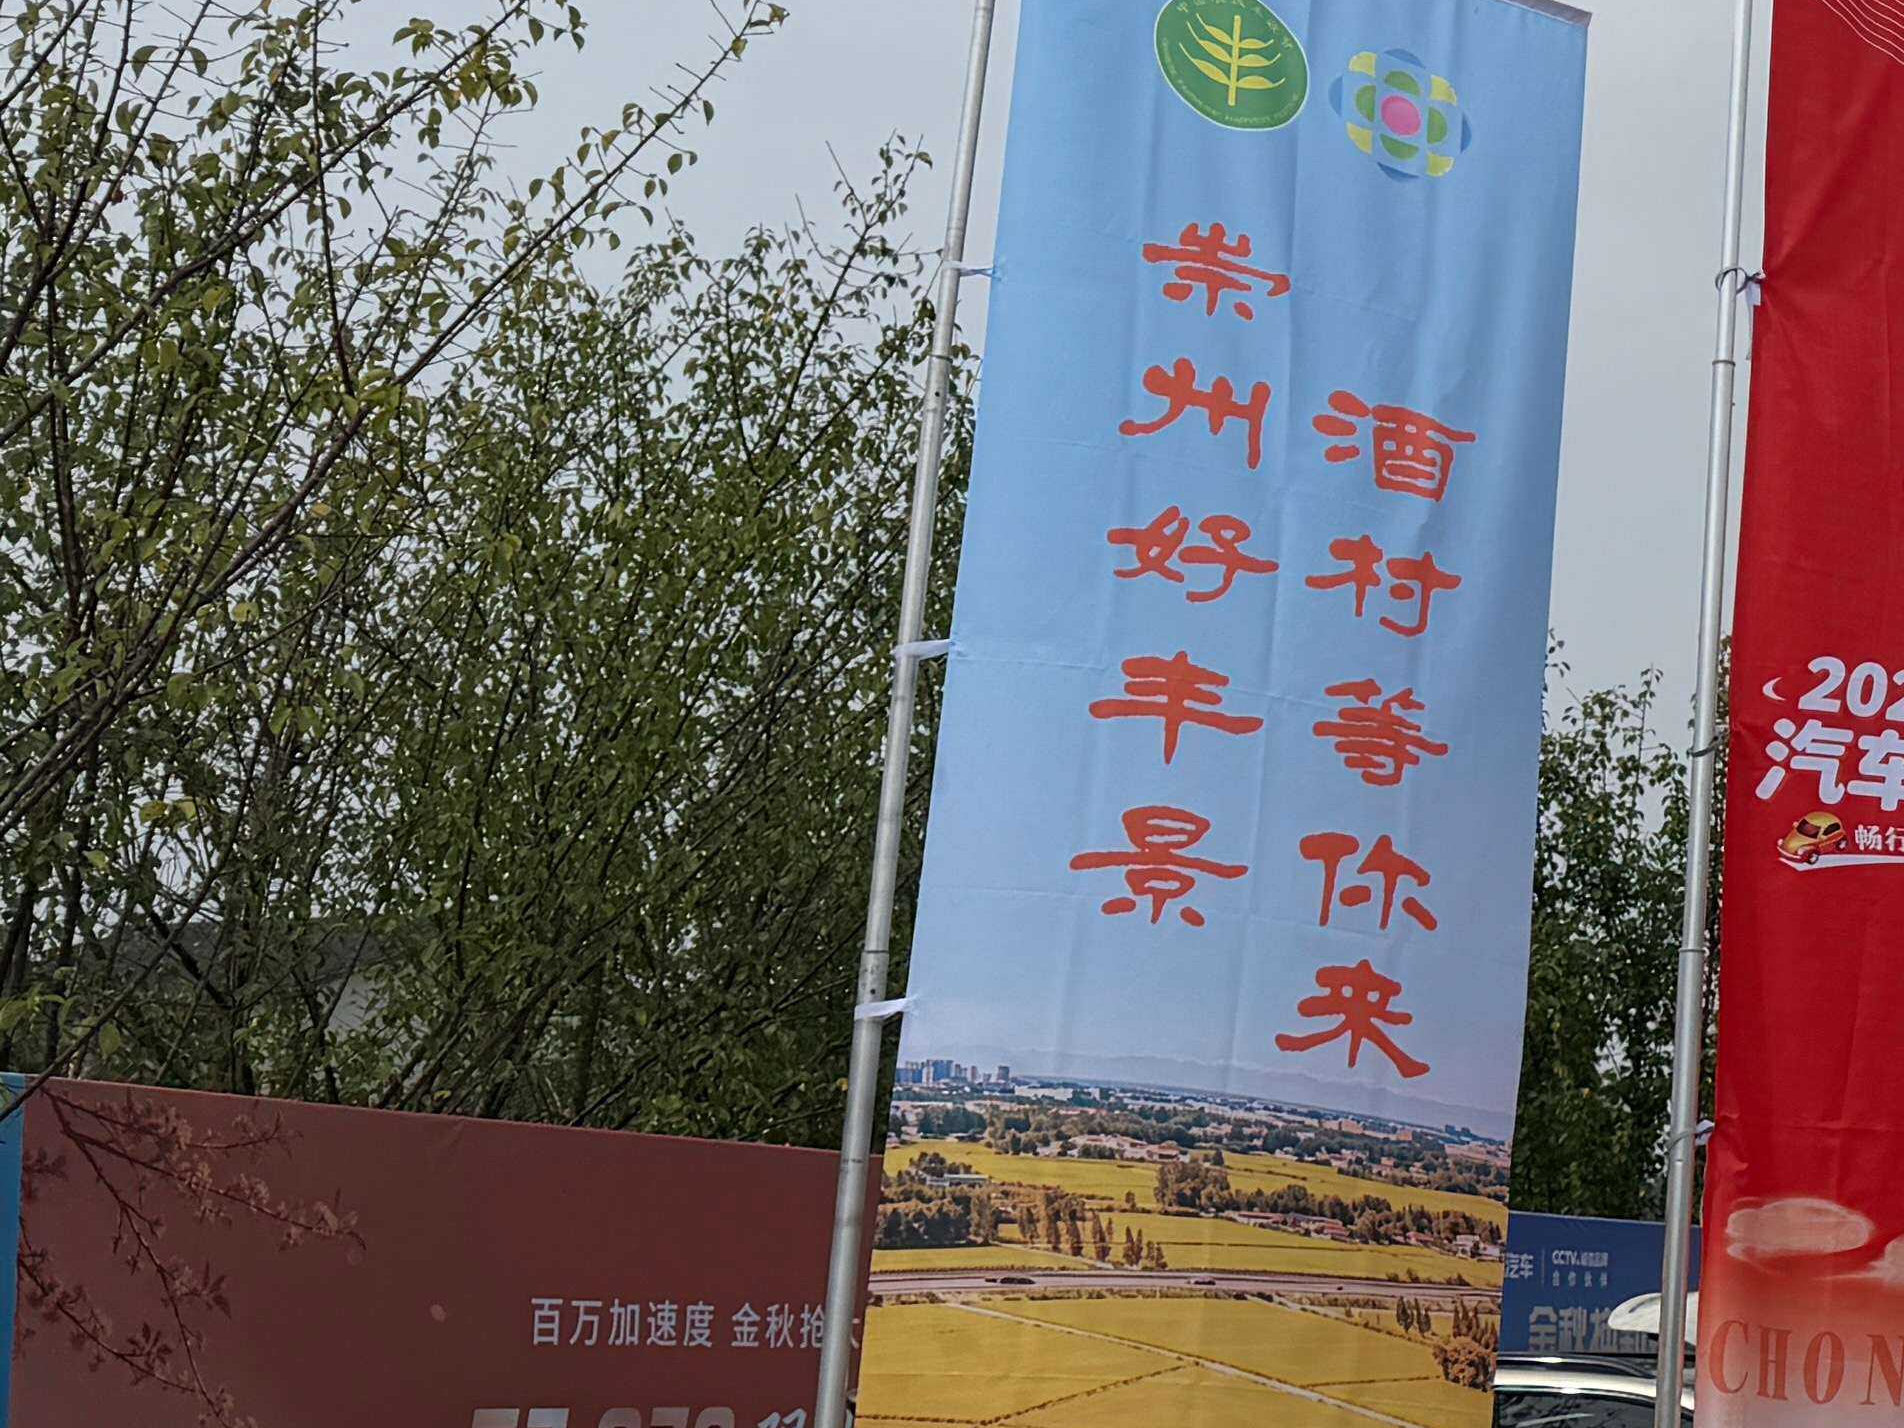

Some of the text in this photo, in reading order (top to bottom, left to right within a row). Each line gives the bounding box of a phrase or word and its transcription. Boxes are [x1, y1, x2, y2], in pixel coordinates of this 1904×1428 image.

[1070, 222, 1290, 928] 崇州好丰景
[1275, 390, 1477, 1079] 酒村等你来
[530, 1297, 715, 1349] 百万加速度
